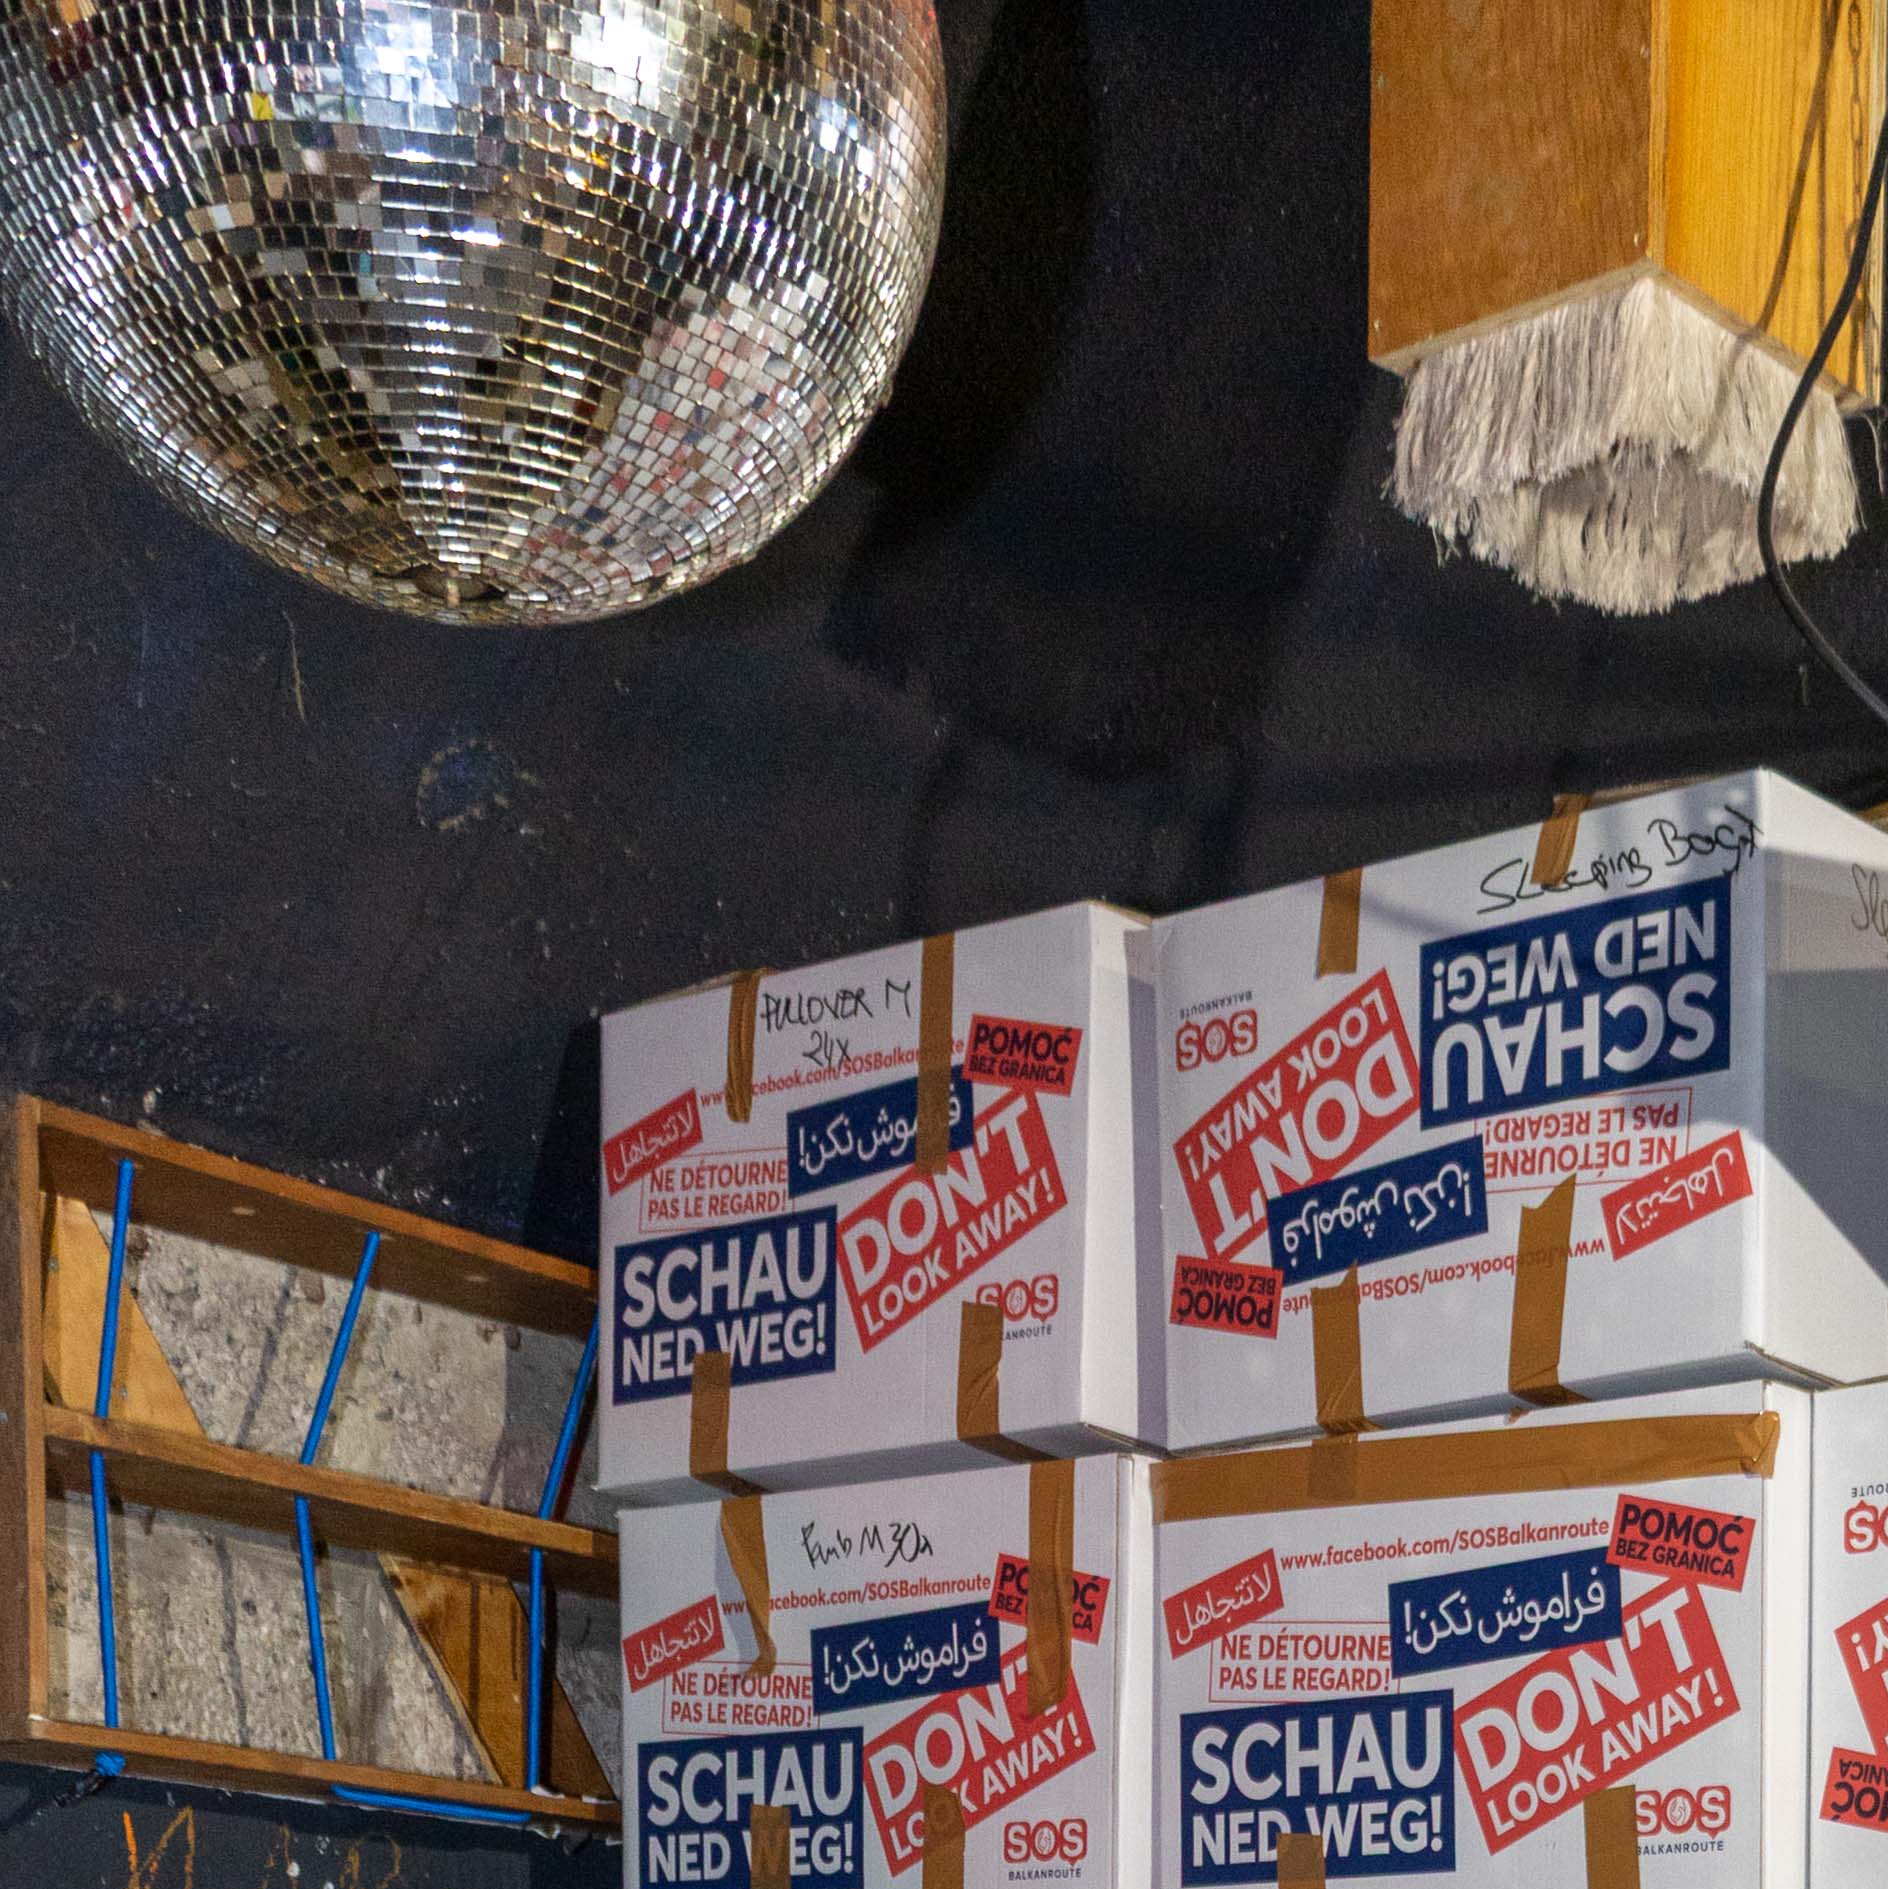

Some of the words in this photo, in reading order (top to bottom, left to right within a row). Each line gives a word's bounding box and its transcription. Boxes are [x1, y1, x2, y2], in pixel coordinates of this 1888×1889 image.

[1432, 928, 1576, 1020] WEG!
[1593, 895, 1711, 980] NED
[973, 1021, 1070, 1066] POMOĆ
[1178, 989, 1253, 1018] BALKANROUTE
[1431, 965, 1713, 1112] SCHAU
[969, 1055, 996, 1075] BEZ
[998, 1057, 1063, 1084] GRANICA
[622, 1221, 828, 1327] SCHAU
[646, 1742, 855, 1824] SCHAU
[1189, 1706, 1443, 1801] SCHAU
[1486, 1747, 1597, 1836] LOOK
[1602, 1667, 1724, 1773] AWAY!
[1008, 1822, 1082, 1861] SOS
[1009, 1869, 1081, 1881] BALKANROUTE
